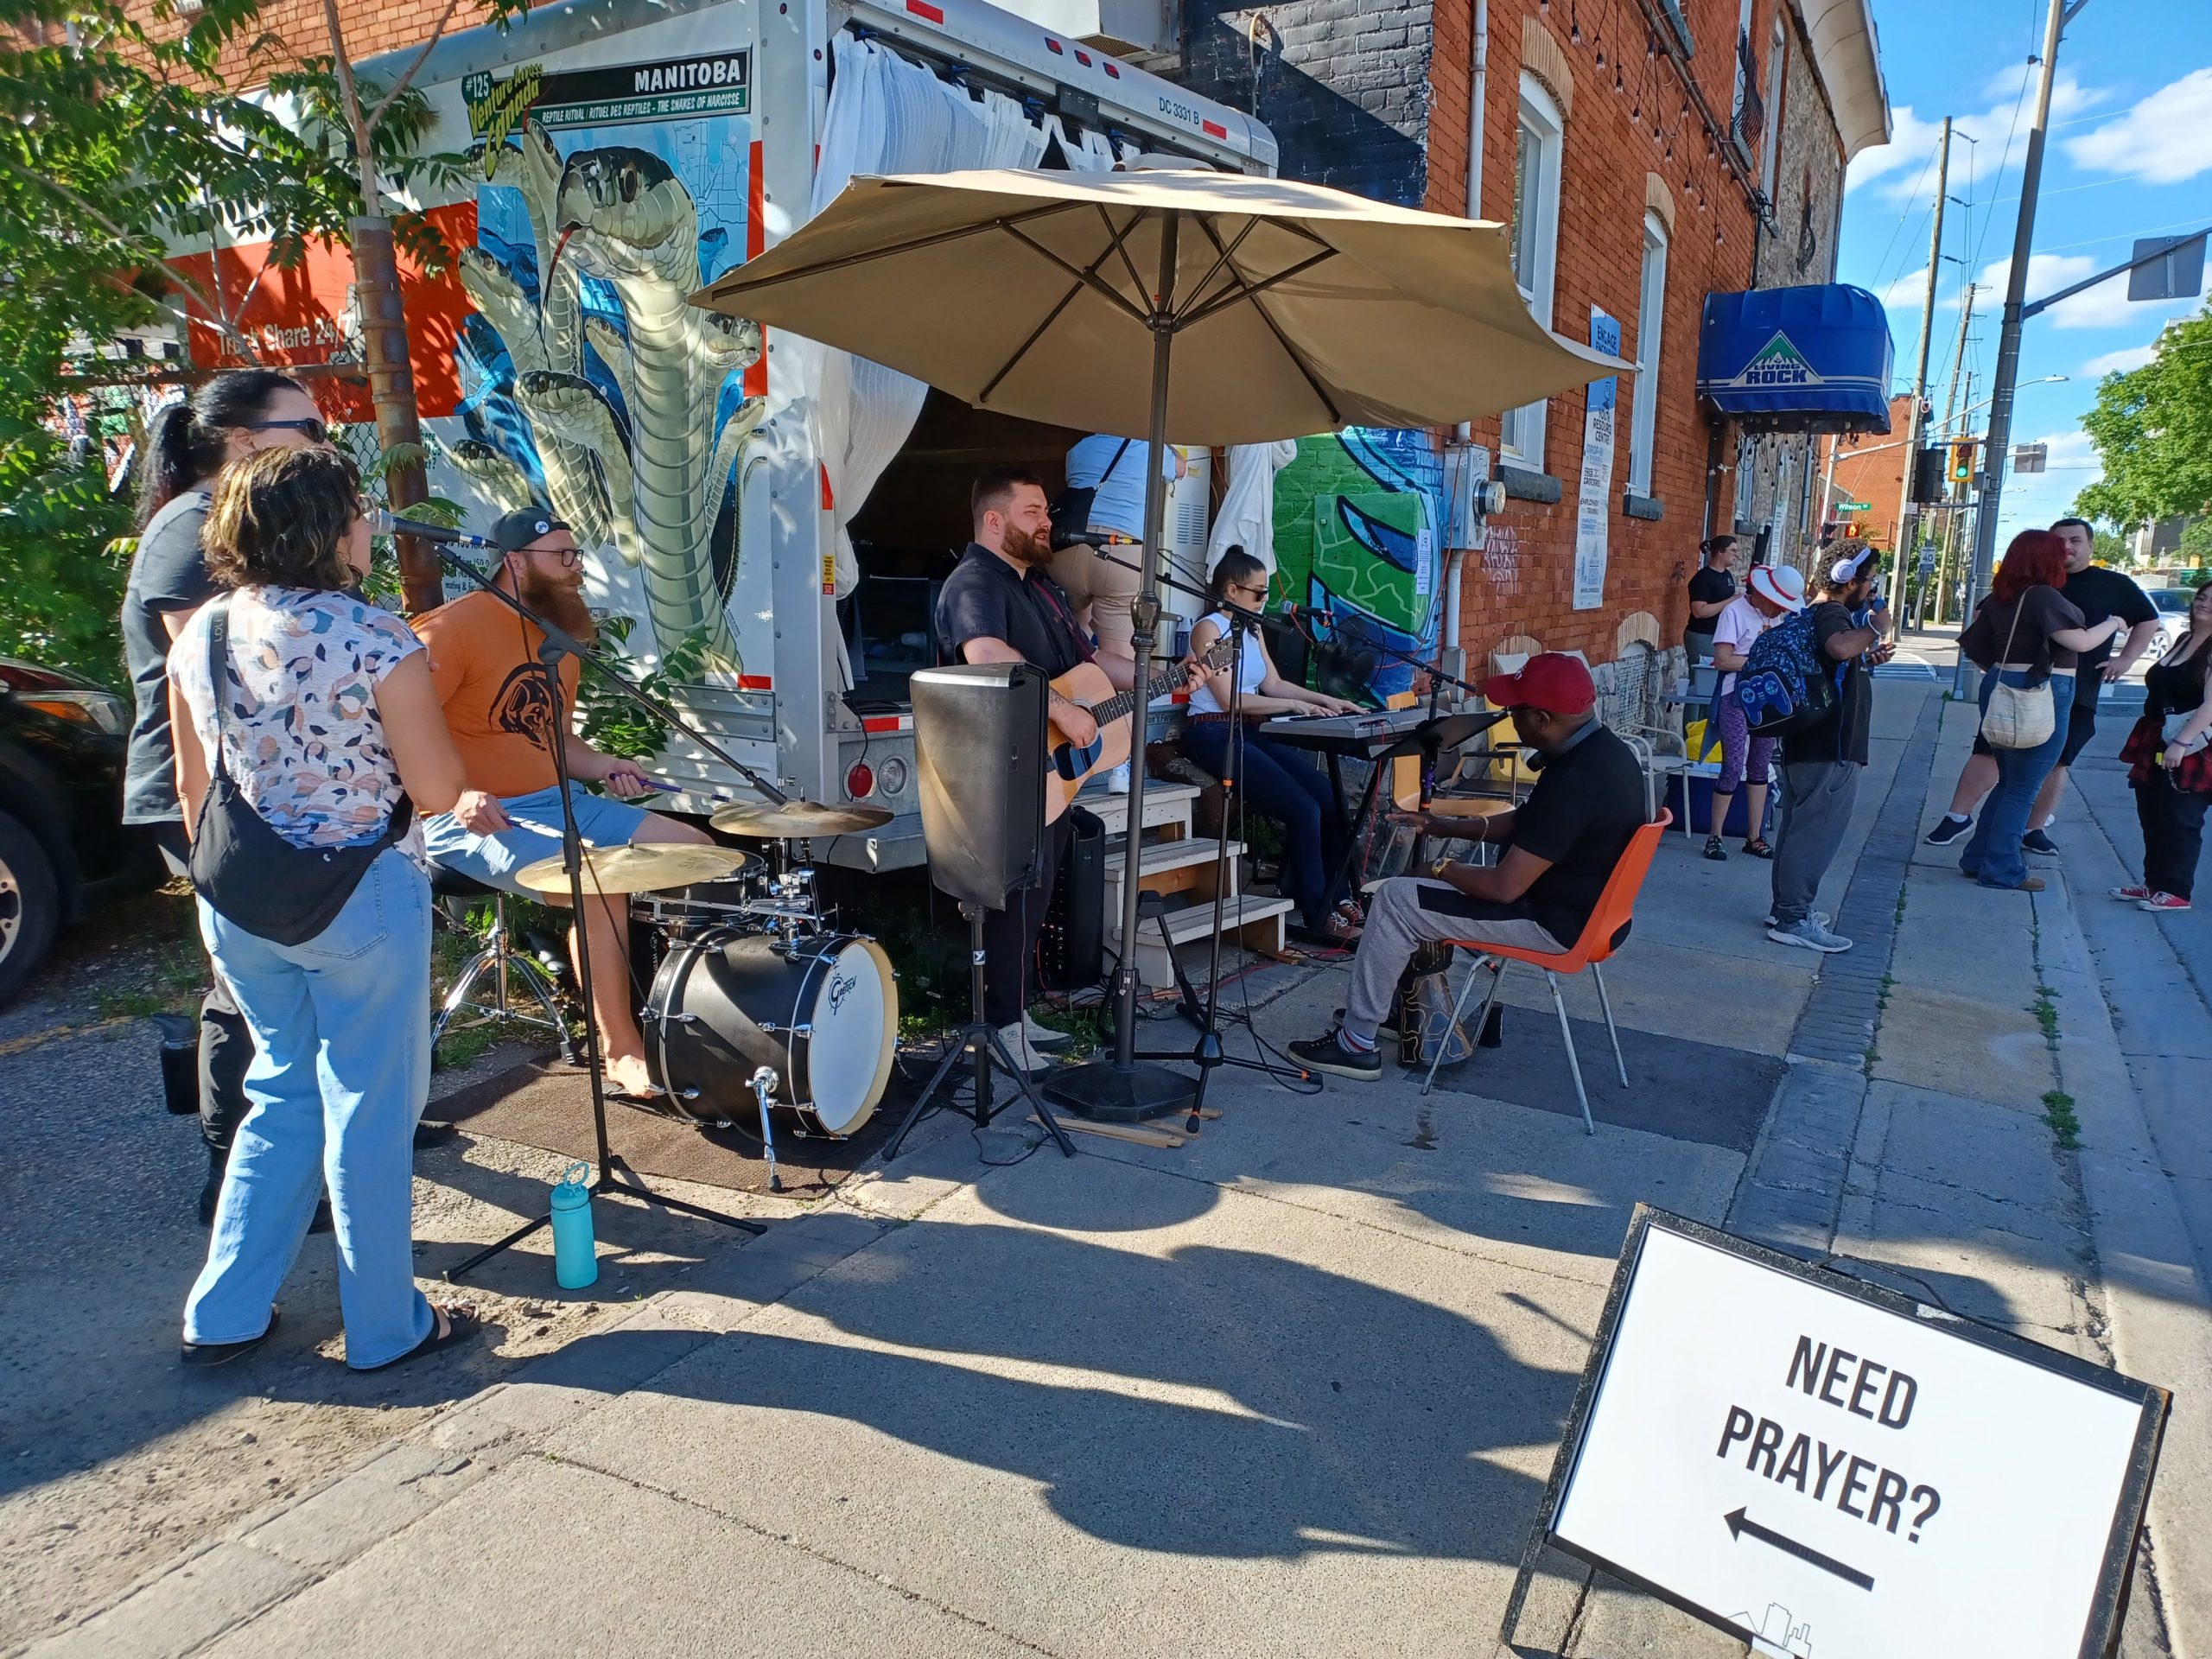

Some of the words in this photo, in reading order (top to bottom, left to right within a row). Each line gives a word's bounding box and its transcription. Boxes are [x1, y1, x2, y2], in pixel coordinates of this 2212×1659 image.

[466, 73, 489, 98] #125
[634, 59, 741, 92] MANITOBA
[468, 78, 513, 140] Venture
[513, 63, 543, 87] Across
[543, 110, 564, 124] REPTILE
[564, 108, 584, 122] RITUAL
[589, 105, 609, 118] RITUEL
[610, 104, 622, 118] DES
[623, 101, 651, 116] REPTILES
[658, 99, 669, 112] THE
[670, 97, 695, 111] SNAKES
[696, 95, 706, 108] OF
[707, 92, 741, 107] NARCISSE
[1159, 96, 1172, 114] DC
[1173, 103, 1191, 122] 3331
[1193, 111, 1200, 125] B
[485, 78, 540, 181] Canada
[264, 323, 311, 351] Share
[1746, 370, 1808, 385] ROCK
[1592, 417, 1612, 435] RESOURCE
[1923, 554, 1934, 563] 40
[1785, 1334, 1918, 1430] NEED
[1716, 1405, 1942, 1546] PRAYER?
